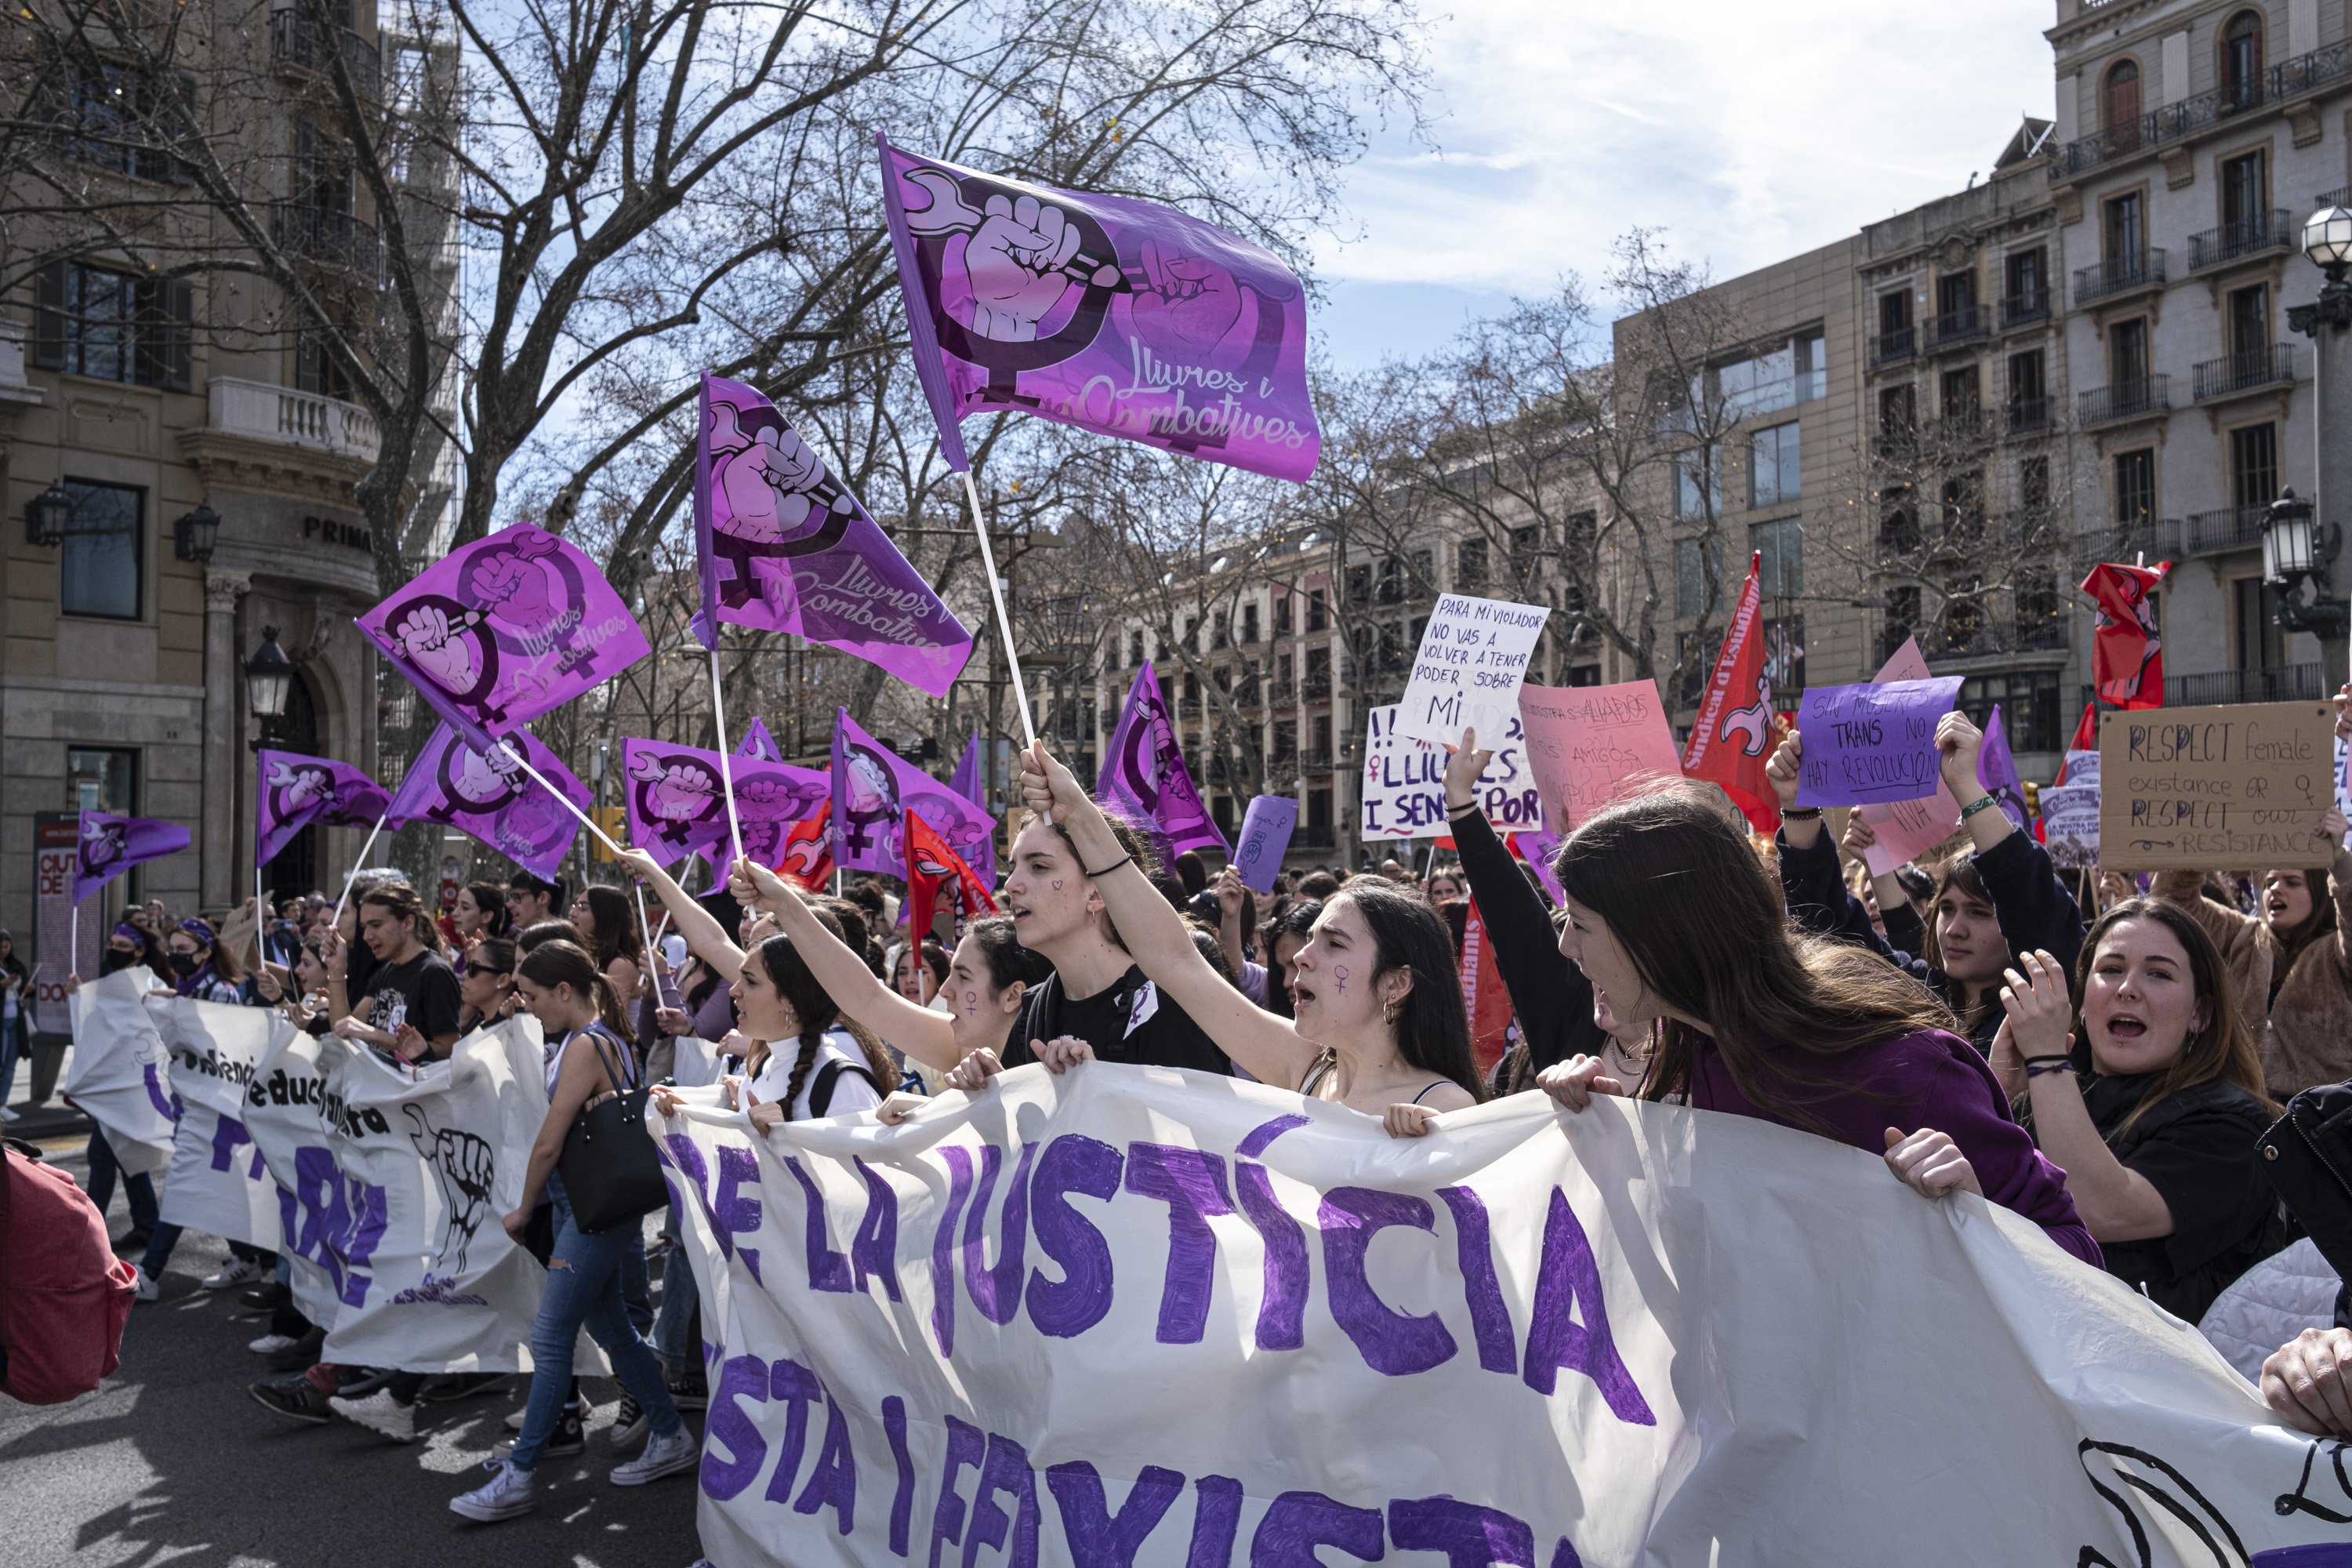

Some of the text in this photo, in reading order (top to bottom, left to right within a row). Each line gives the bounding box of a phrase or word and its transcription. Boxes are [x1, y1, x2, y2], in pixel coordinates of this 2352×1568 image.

[1116, 335, 1275, 400] Lliures i
[1063, 375, 1310, 449] Combatives
[817, 554, 936, 618] Lliures
[1437, 598, 1470, 619] PARA
[1430, 622, 1497, 647] NO VAS A
[513, 615, 627, 696] Cmbatives
[1424, 644, 1527, 667] VOLVER A TENER
[1414, 664, 1517, 688] PODER SOBRE
[1813, 687, 1930, 720] SIN MUJERES
[1684, 688, 1726, 770] Sindicat
[1831, 717, 1926, 750] TRANS NO
[2129, 723, 2234, 762] RESPECT
[1383, 748, 1517, 787] LLIUS
[1573, 746, 1639, 764] AMIGOS
[1807, 759, 1828, 789] HAY
[2129, 771, 2232, 797] existance
[1364, 786, 1539, 831] I SEN POR
[2132, 798, 2302, 829] RESPECT our
[41, 876, 64, 895] DE
[784, 1154, 903, 1305] LA
[931, 1112, 1657, 1427] JUSTÍCIA
[700, 1341, 1586, 1568] STA I FEIXI
